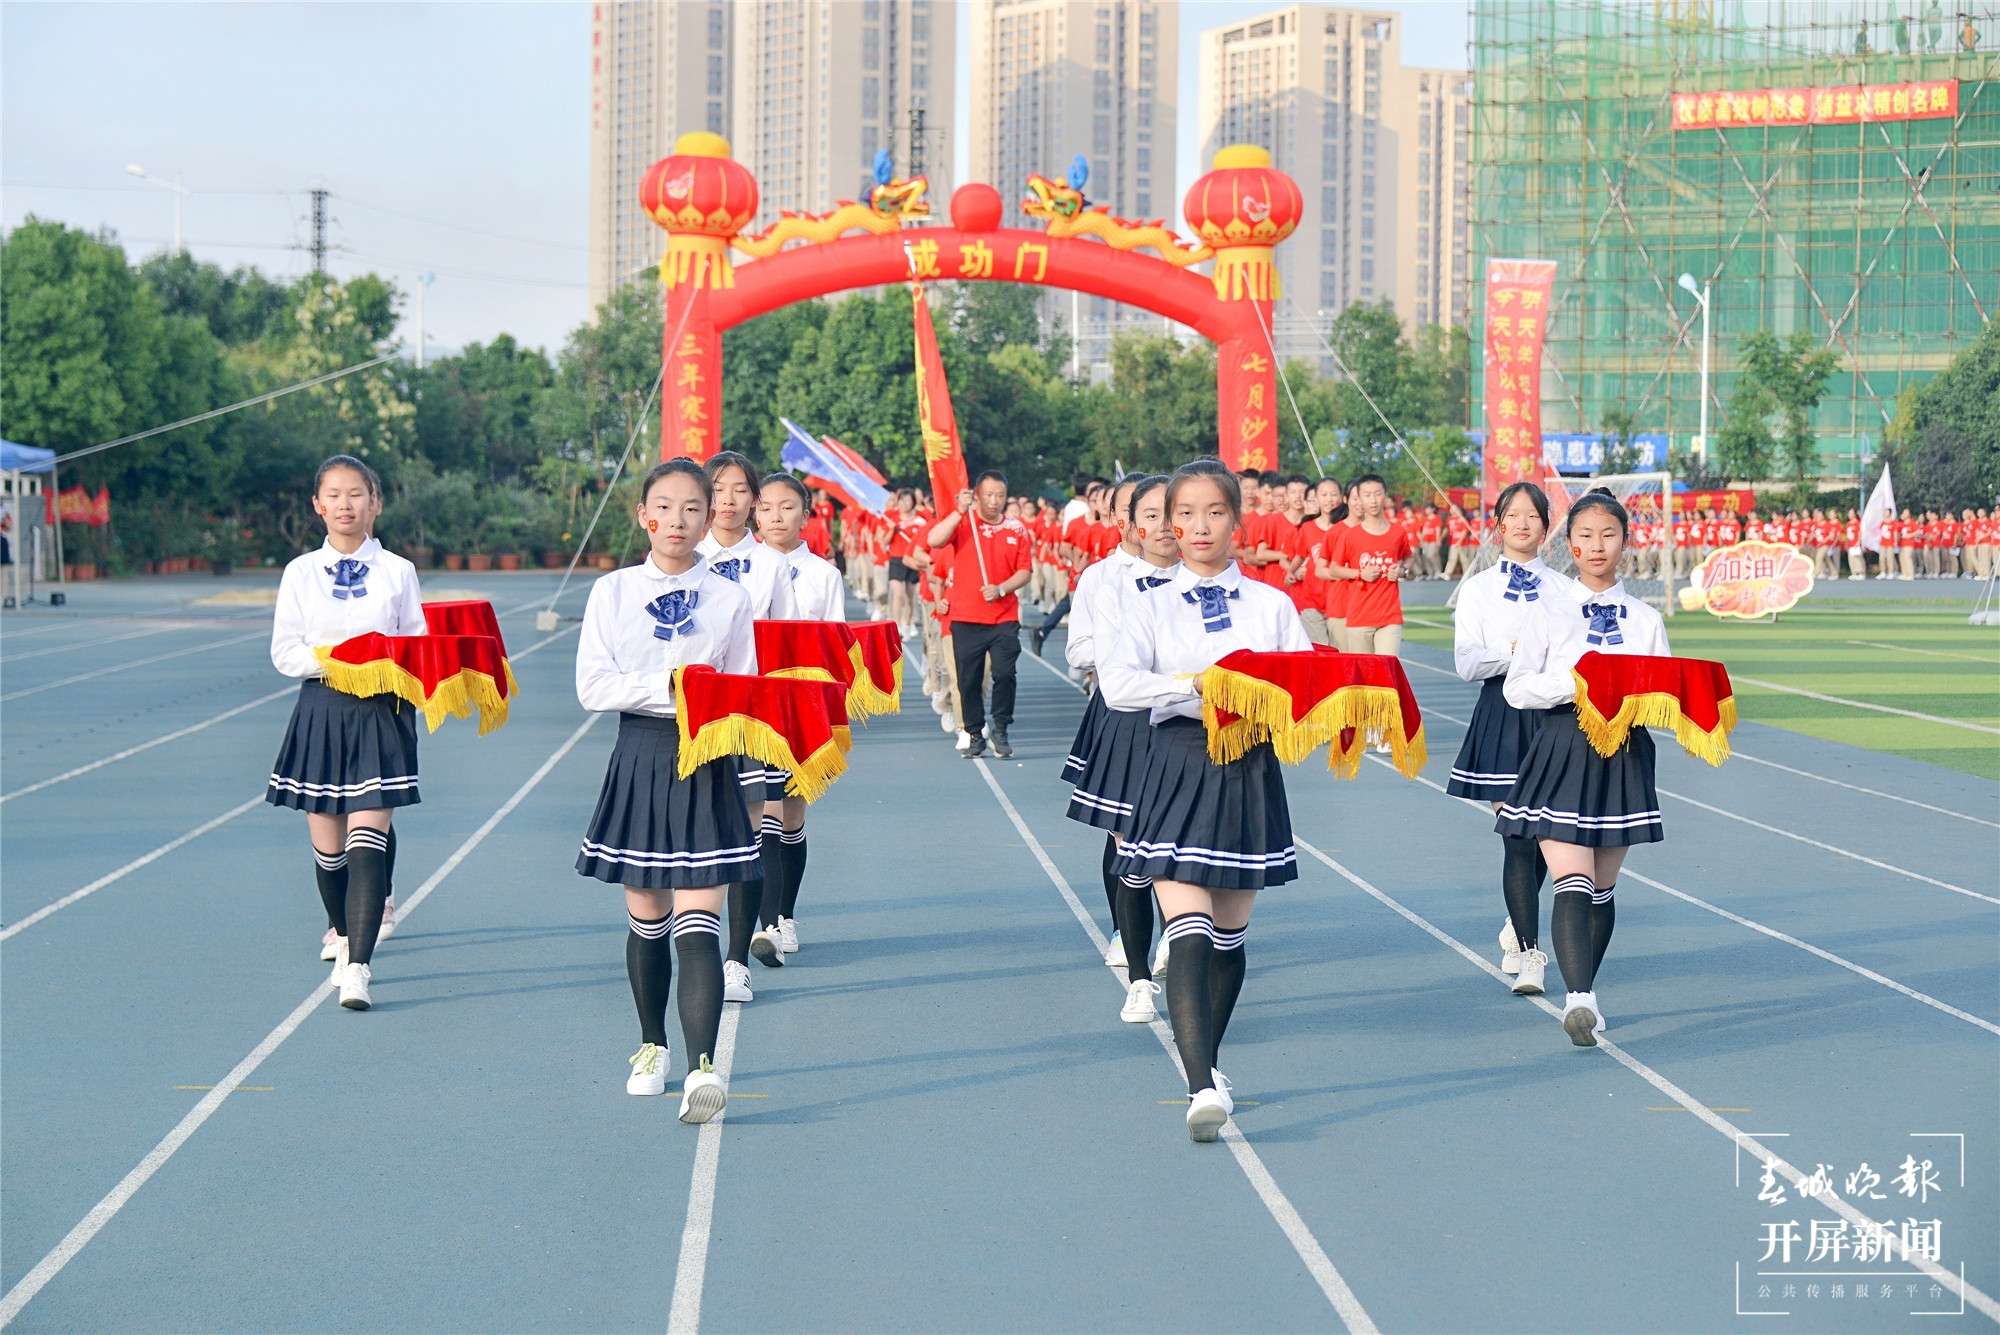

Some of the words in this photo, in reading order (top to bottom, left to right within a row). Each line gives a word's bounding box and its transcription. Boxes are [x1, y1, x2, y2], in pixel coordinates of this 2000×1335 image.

[906, 238, 1048, 281] 成功门
[676, 333, 709, 466] 三年寒窗
[1238, 352, 1269, 472] 七月沙场
[1492, 288, 1518, 493] 今天你以学校为
